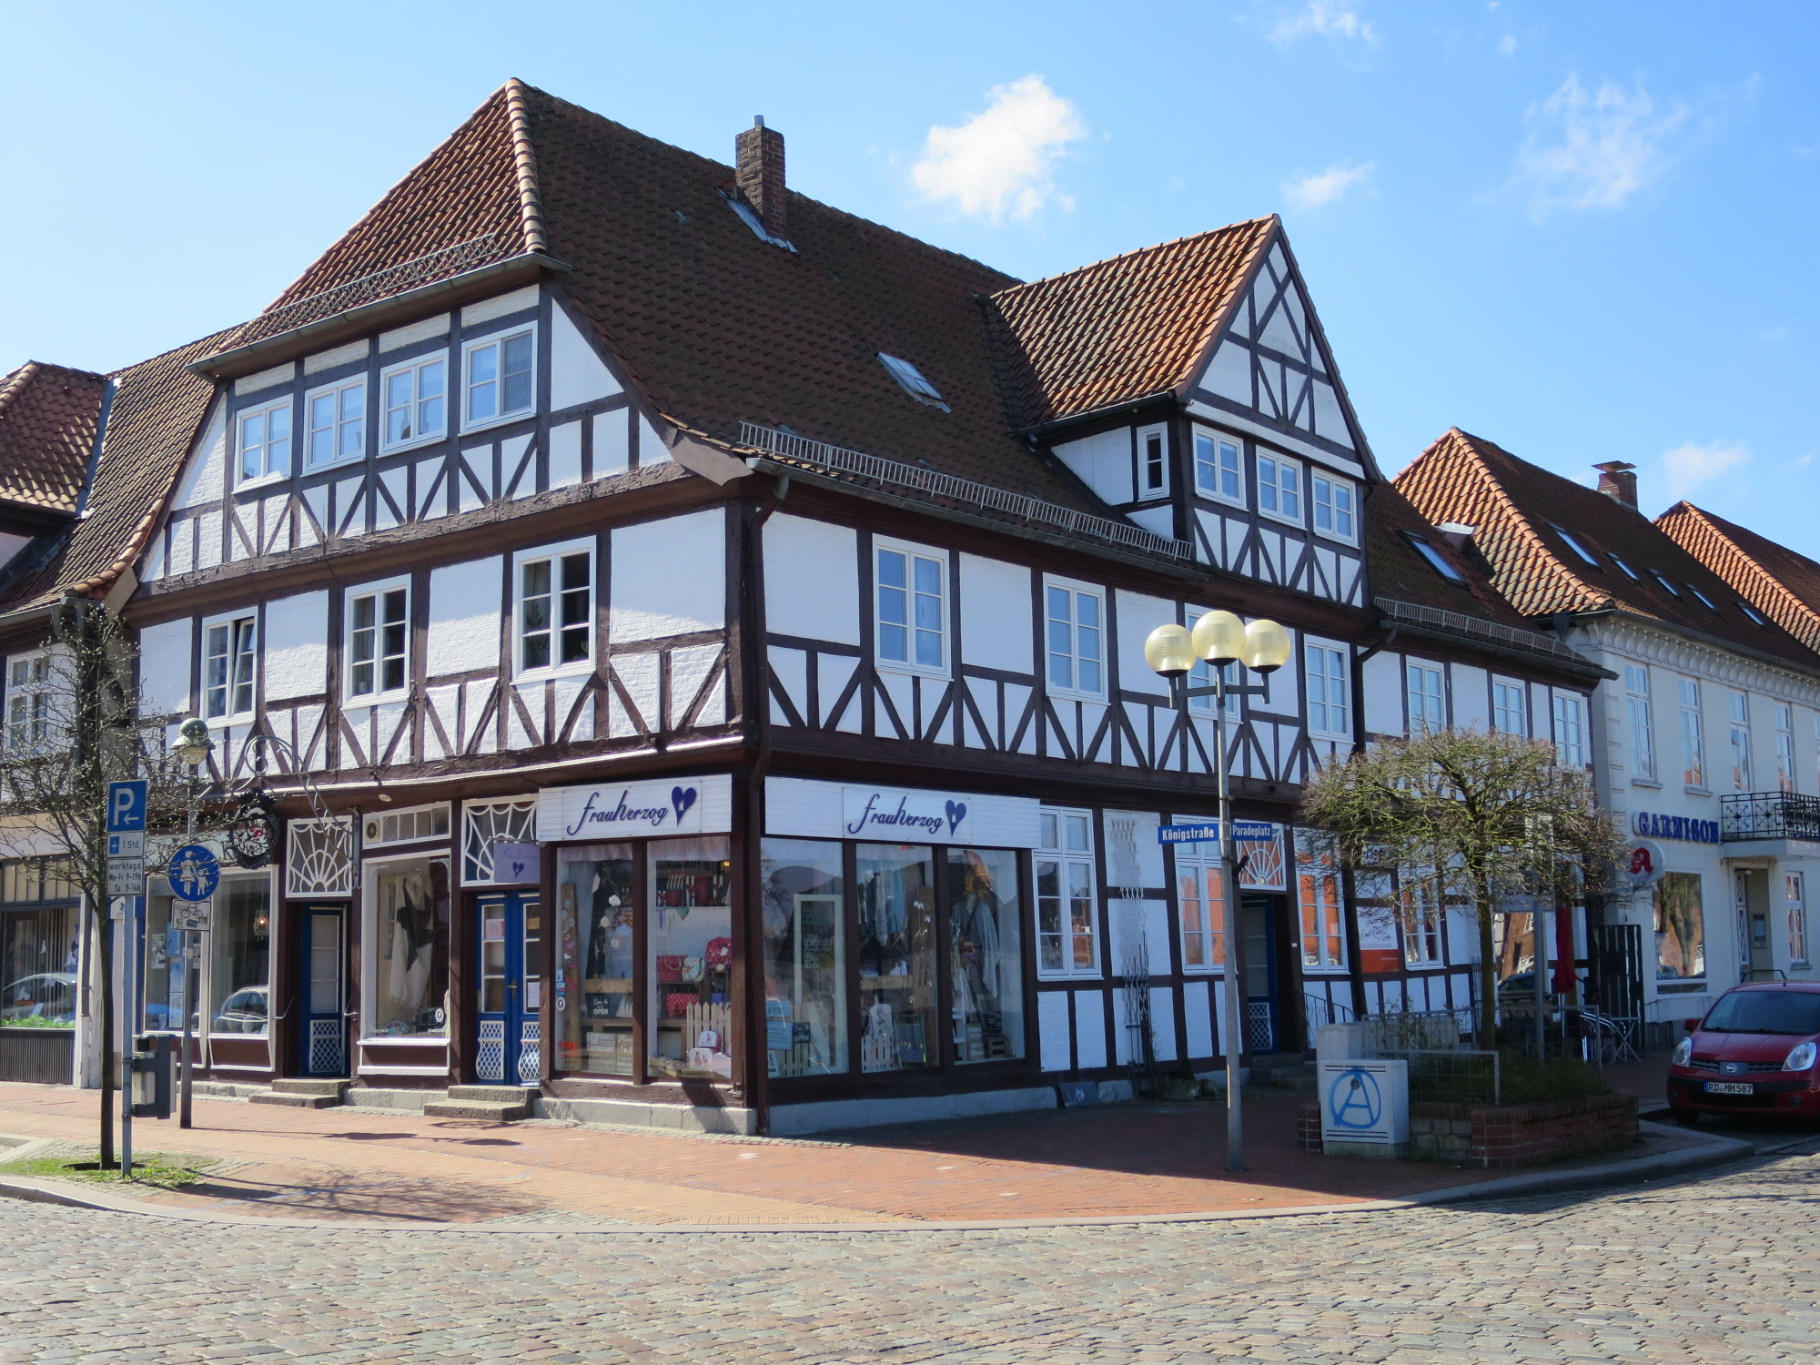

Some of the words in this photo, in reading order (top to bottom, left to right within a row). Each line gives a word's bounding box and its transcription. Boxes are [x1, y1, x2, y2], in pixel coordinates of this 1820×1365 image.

[113, 788, 135, 826] P
[566, 789, 669, 836] frauherzog
[847, 793, 944, 835] frauherzog
[1162, 826, 1215, 842] Königstraße
[1232, 824, 1271, 839] Paradeplatz
[1639, 811, 1719, 844] GARNISON
[109, 862, 141, 872] werktags
[109, 872, 124, 881] Mo-Fr
[115, 883, 121, 893] Sa
[1708, 1083, 1720, 1092] RD
